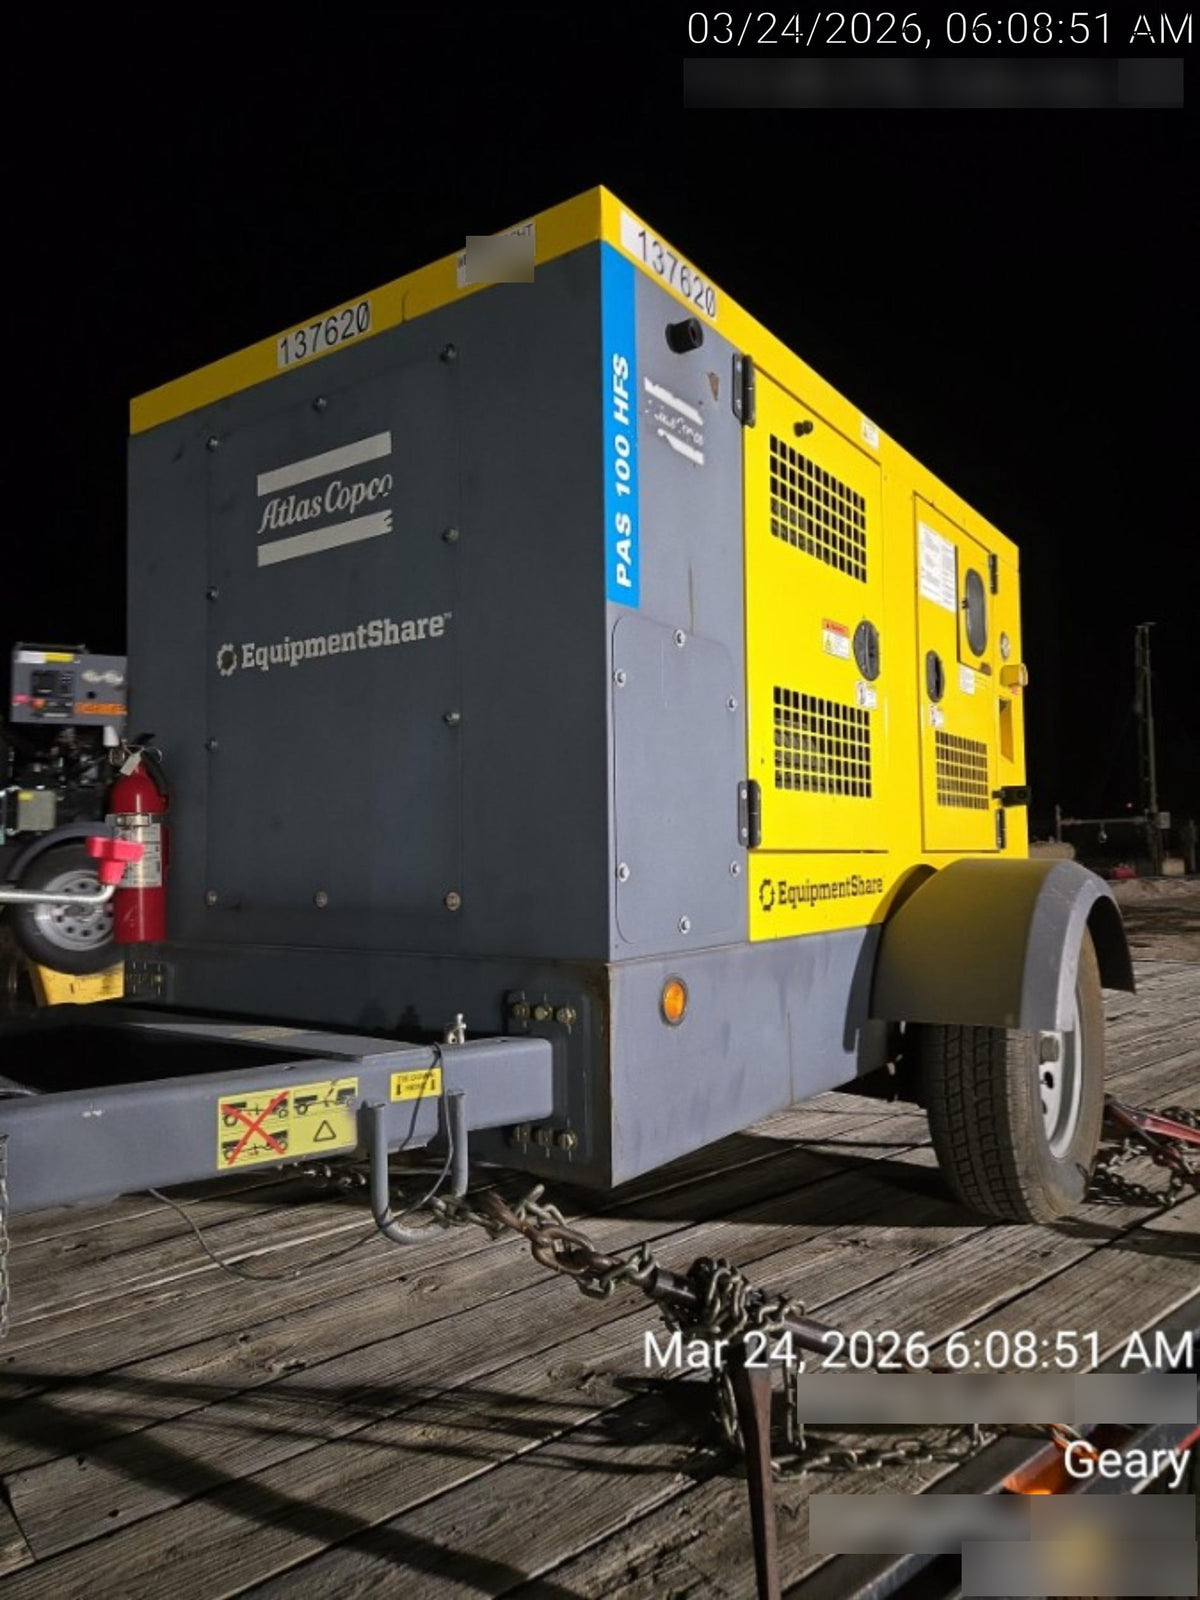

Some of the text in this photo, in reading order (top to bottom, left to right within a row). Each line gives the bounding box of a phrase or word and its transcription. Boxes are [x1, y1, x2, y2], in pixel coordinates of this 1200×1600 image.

[638, 230, 716, 318] 137620
[280, 302, 370, 365] 137620
[612, 353, 632, 588] PAS 100 HFS
[257, 474, 393, 534] Atlas Copco
[778, 874, 883, 909] EquipmentShare
